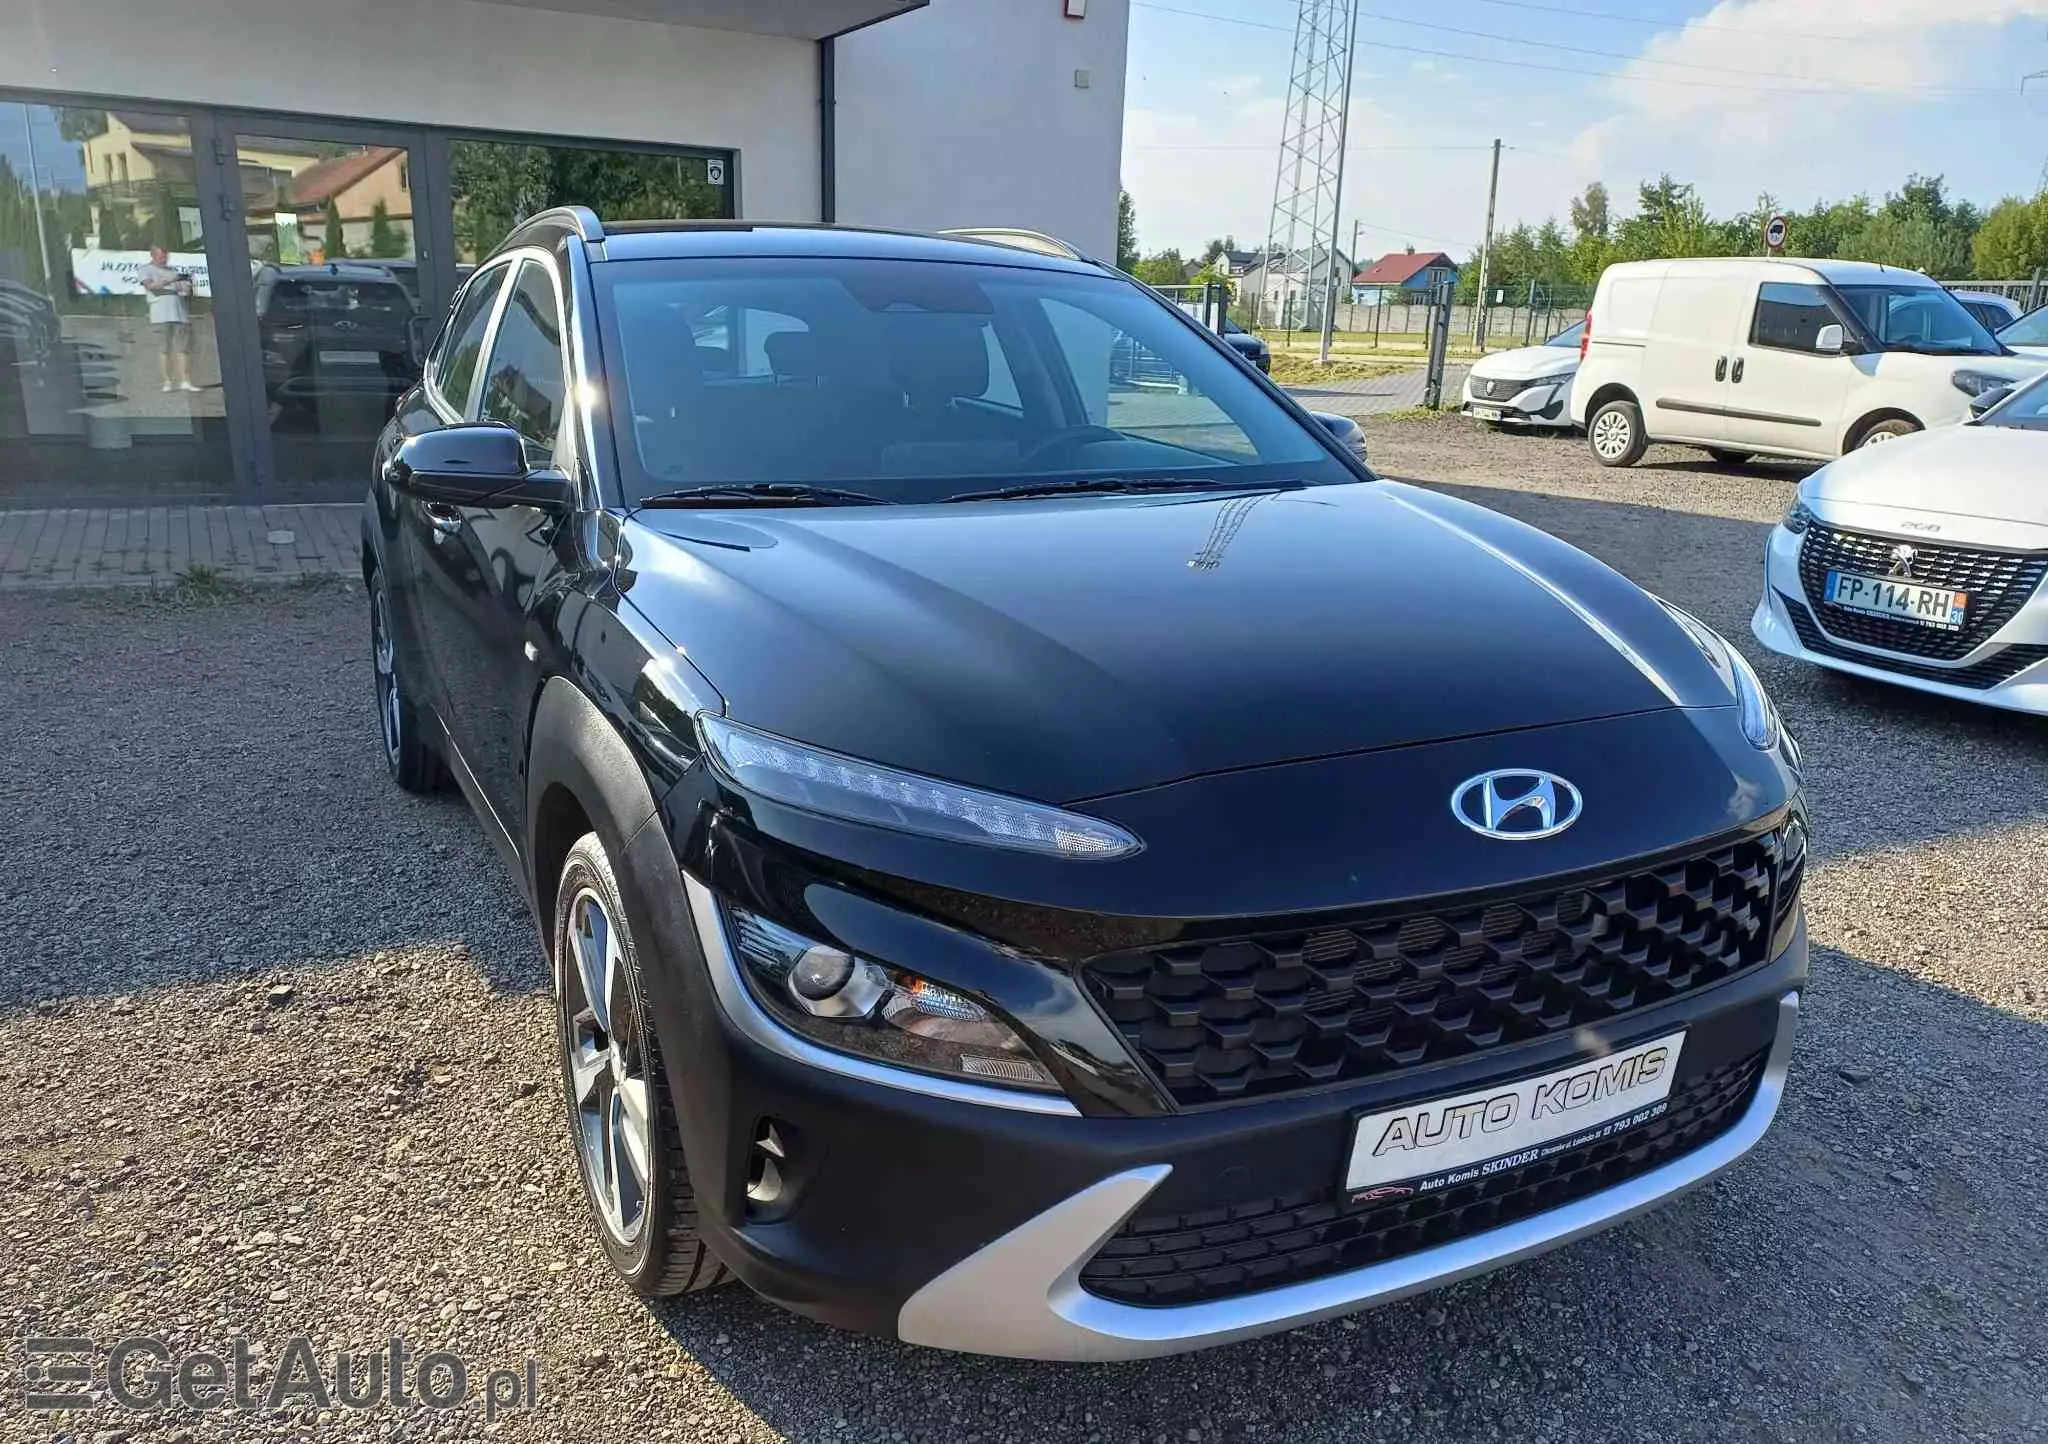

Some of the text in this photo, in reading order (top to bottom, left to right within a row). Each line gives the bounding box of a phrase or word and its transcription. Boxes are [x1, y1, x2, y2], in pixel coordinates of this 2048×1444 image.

[1837, 576, 1950, 618] FP-114-RH
[1372, 1092, 1520, 1157] AUTO
[1531, 1046, 1669, 1120] KOMIS
[1419, 1178, 1446, 1192] Auto
[1447, 1167, 1480, 1185] Komis
[1481, 1148, 1539, 1176] SKINDER
